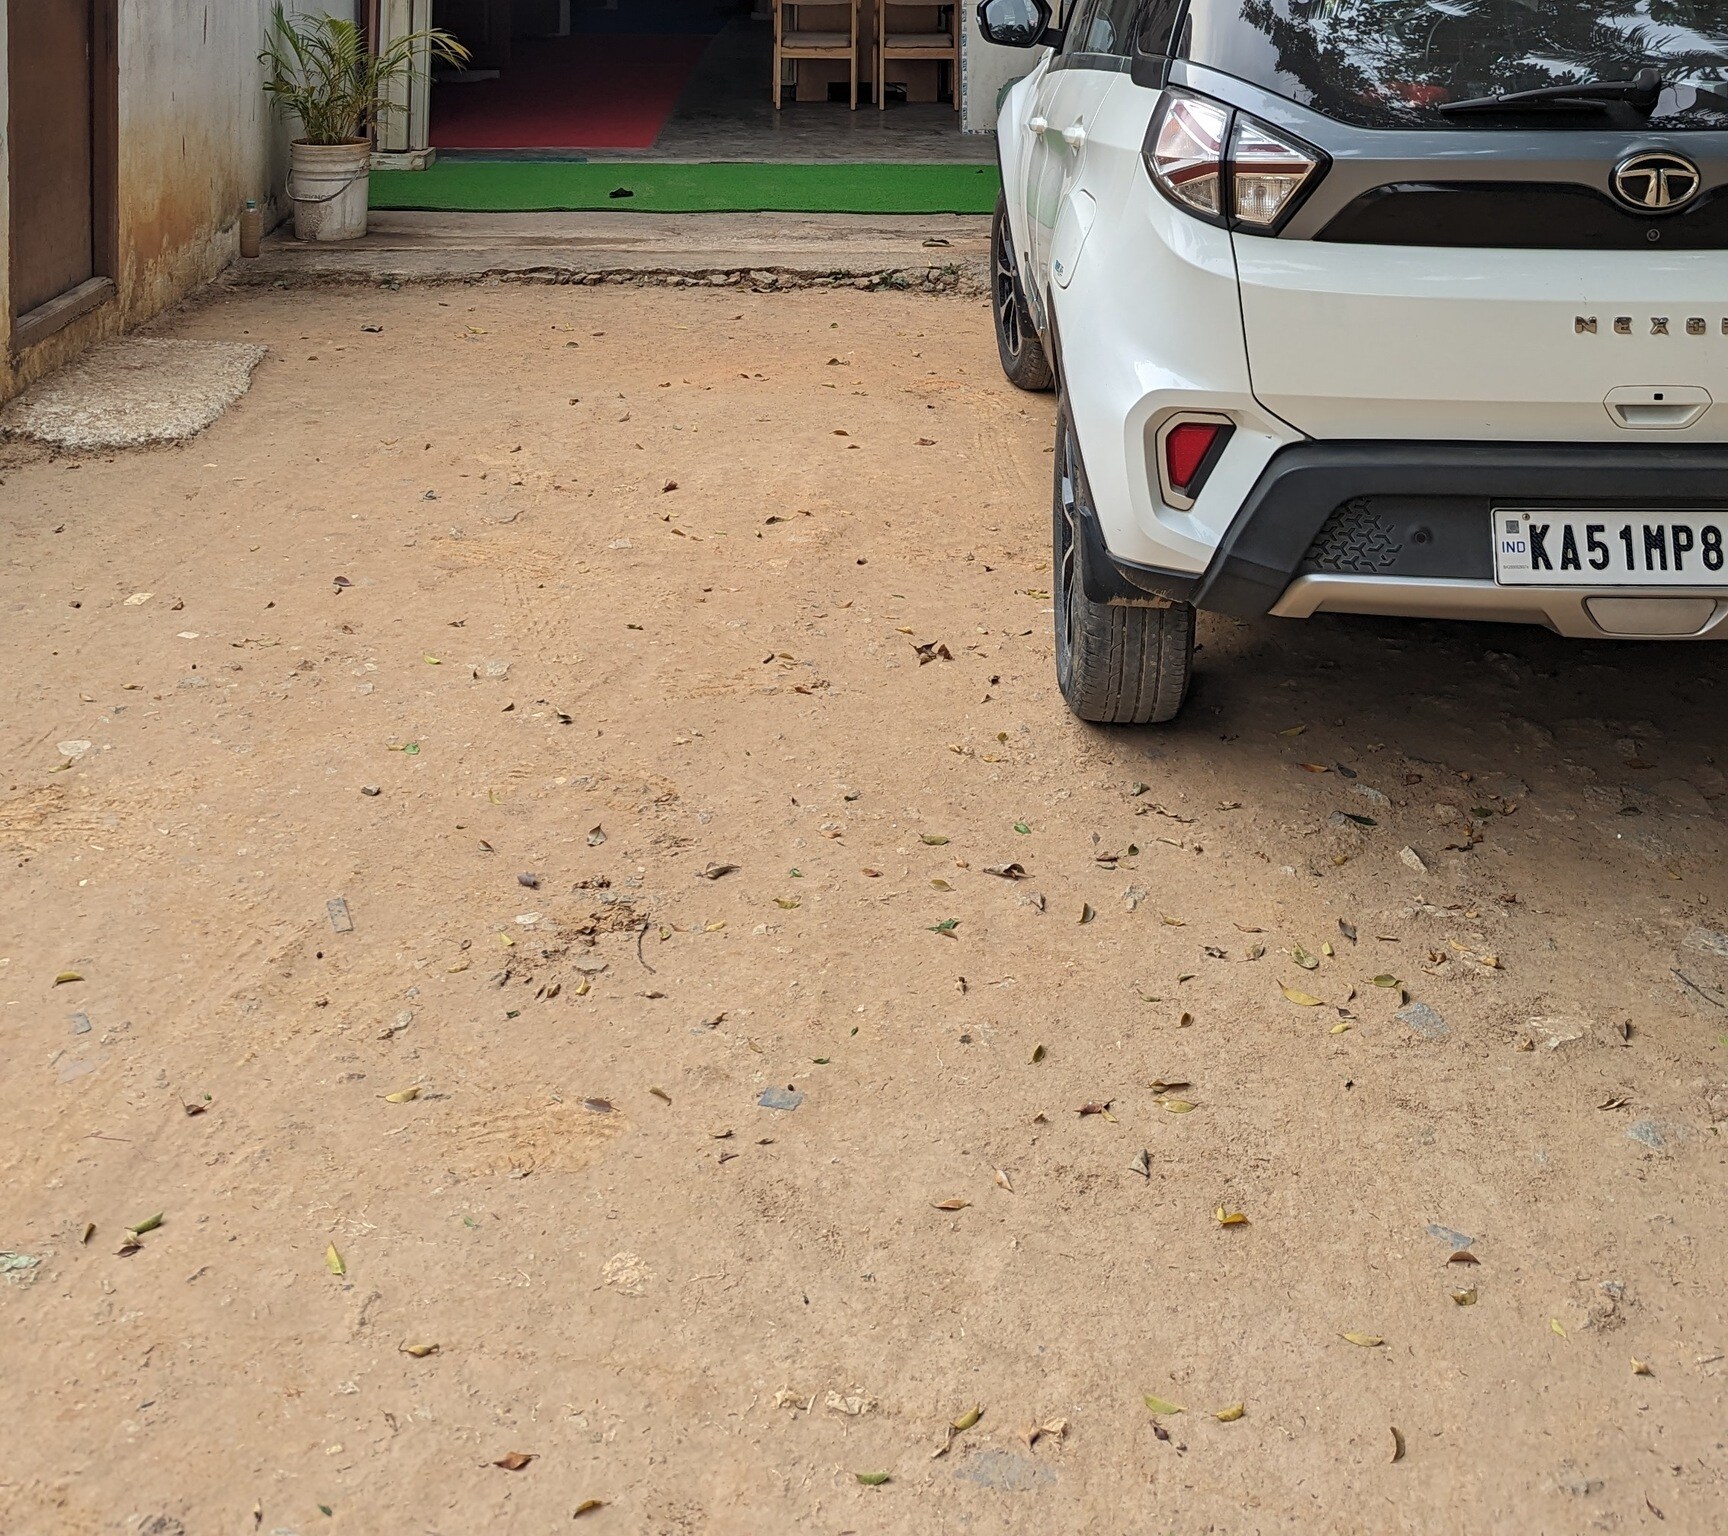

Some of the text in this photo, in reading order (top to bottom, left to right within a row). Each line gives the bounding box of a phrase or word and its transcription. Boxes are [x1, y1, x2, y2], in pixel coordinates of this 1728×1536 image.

[1574, 315, 1728, 336] NEXO
[1502, 541, 1526, 554] IND
[1528, 524, 1725, 571] KA51MP8
